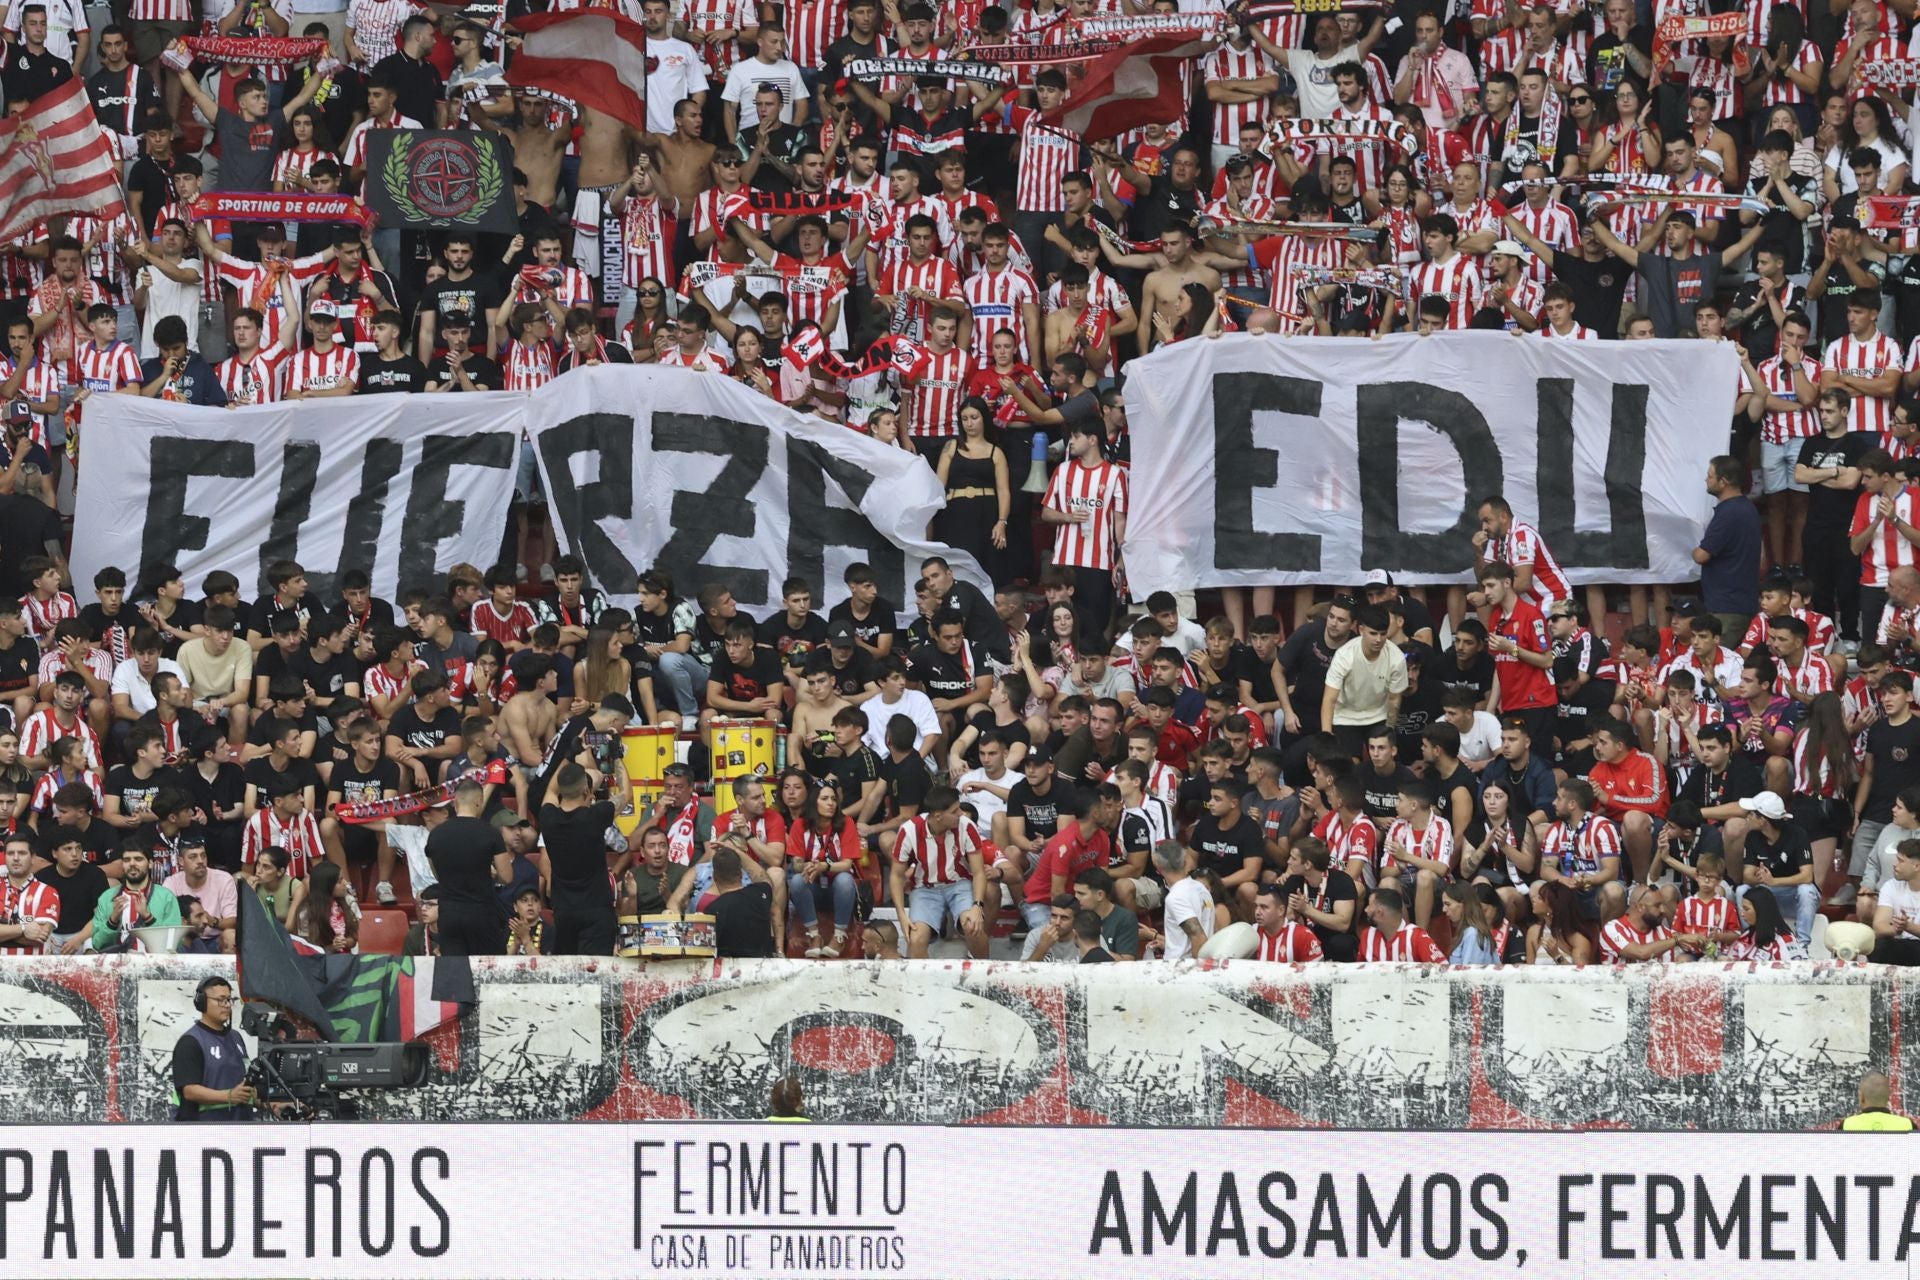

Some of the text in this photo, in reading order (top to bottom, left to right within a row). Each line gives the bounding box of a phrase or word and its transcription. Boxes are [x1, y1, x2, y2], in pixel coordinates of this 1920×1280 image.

[217, 199, 281, 213] SPORTING
[285, 200, 303, 212] DE
[603, 218, 621, 303] BORRACHOS
[1213, 371, 1650, 575] EDU
[930, 679, 975, 690] SIROKO
[0, 1147, 450, 1260] PANADEROS
[633, 1141, 906, 1250] FERMENTO
[1089, 1170, 1920, 1268] AMASAMOS, FERMENTA
[651, 1235, 905, 1270] CASA DE PANADEROS
